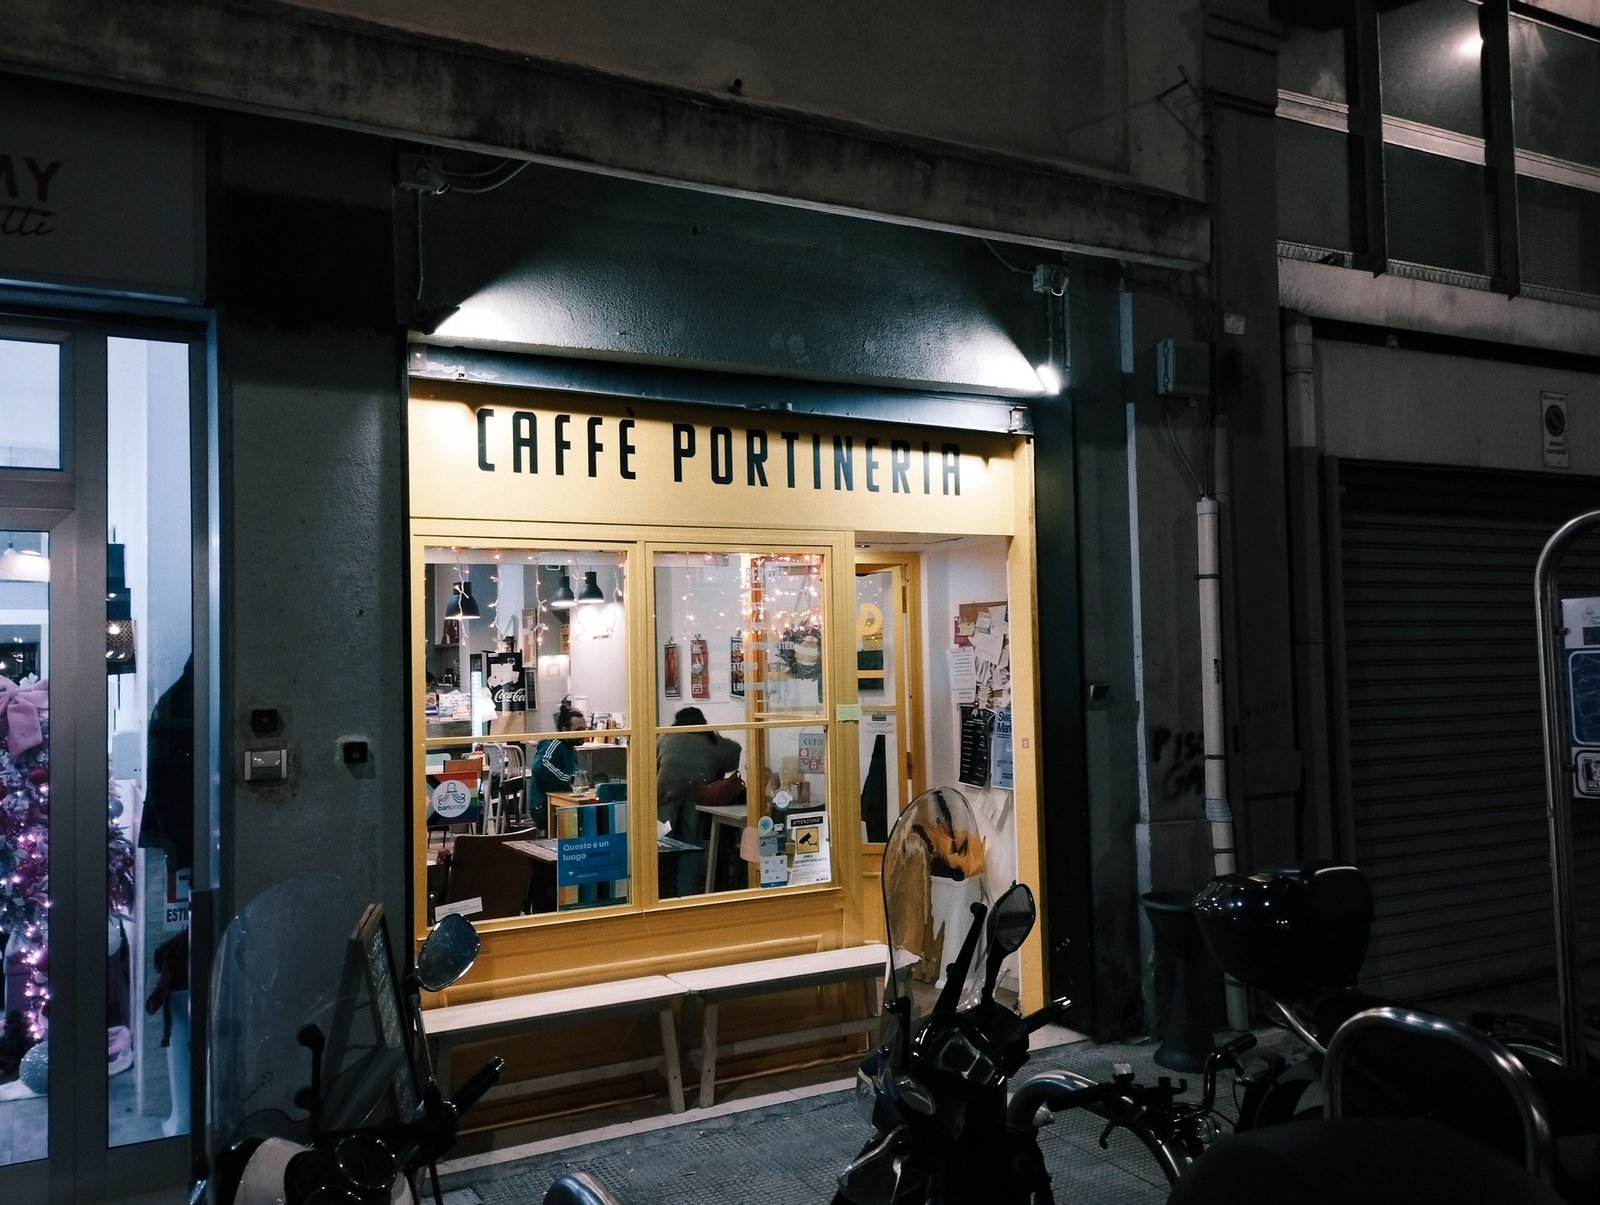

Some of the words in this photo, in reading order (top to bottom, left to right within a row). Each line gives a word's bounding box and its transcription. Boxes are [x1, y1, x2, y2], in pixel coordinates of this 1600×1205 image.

[477, 406, 637, 480] CAFFÈ
[672, 422, 962, 496] PORTINERIA
[562, 842, 592, 852] Questo
[598, 840, 609, 848] un
[562, 853, 587, 862] luogo
